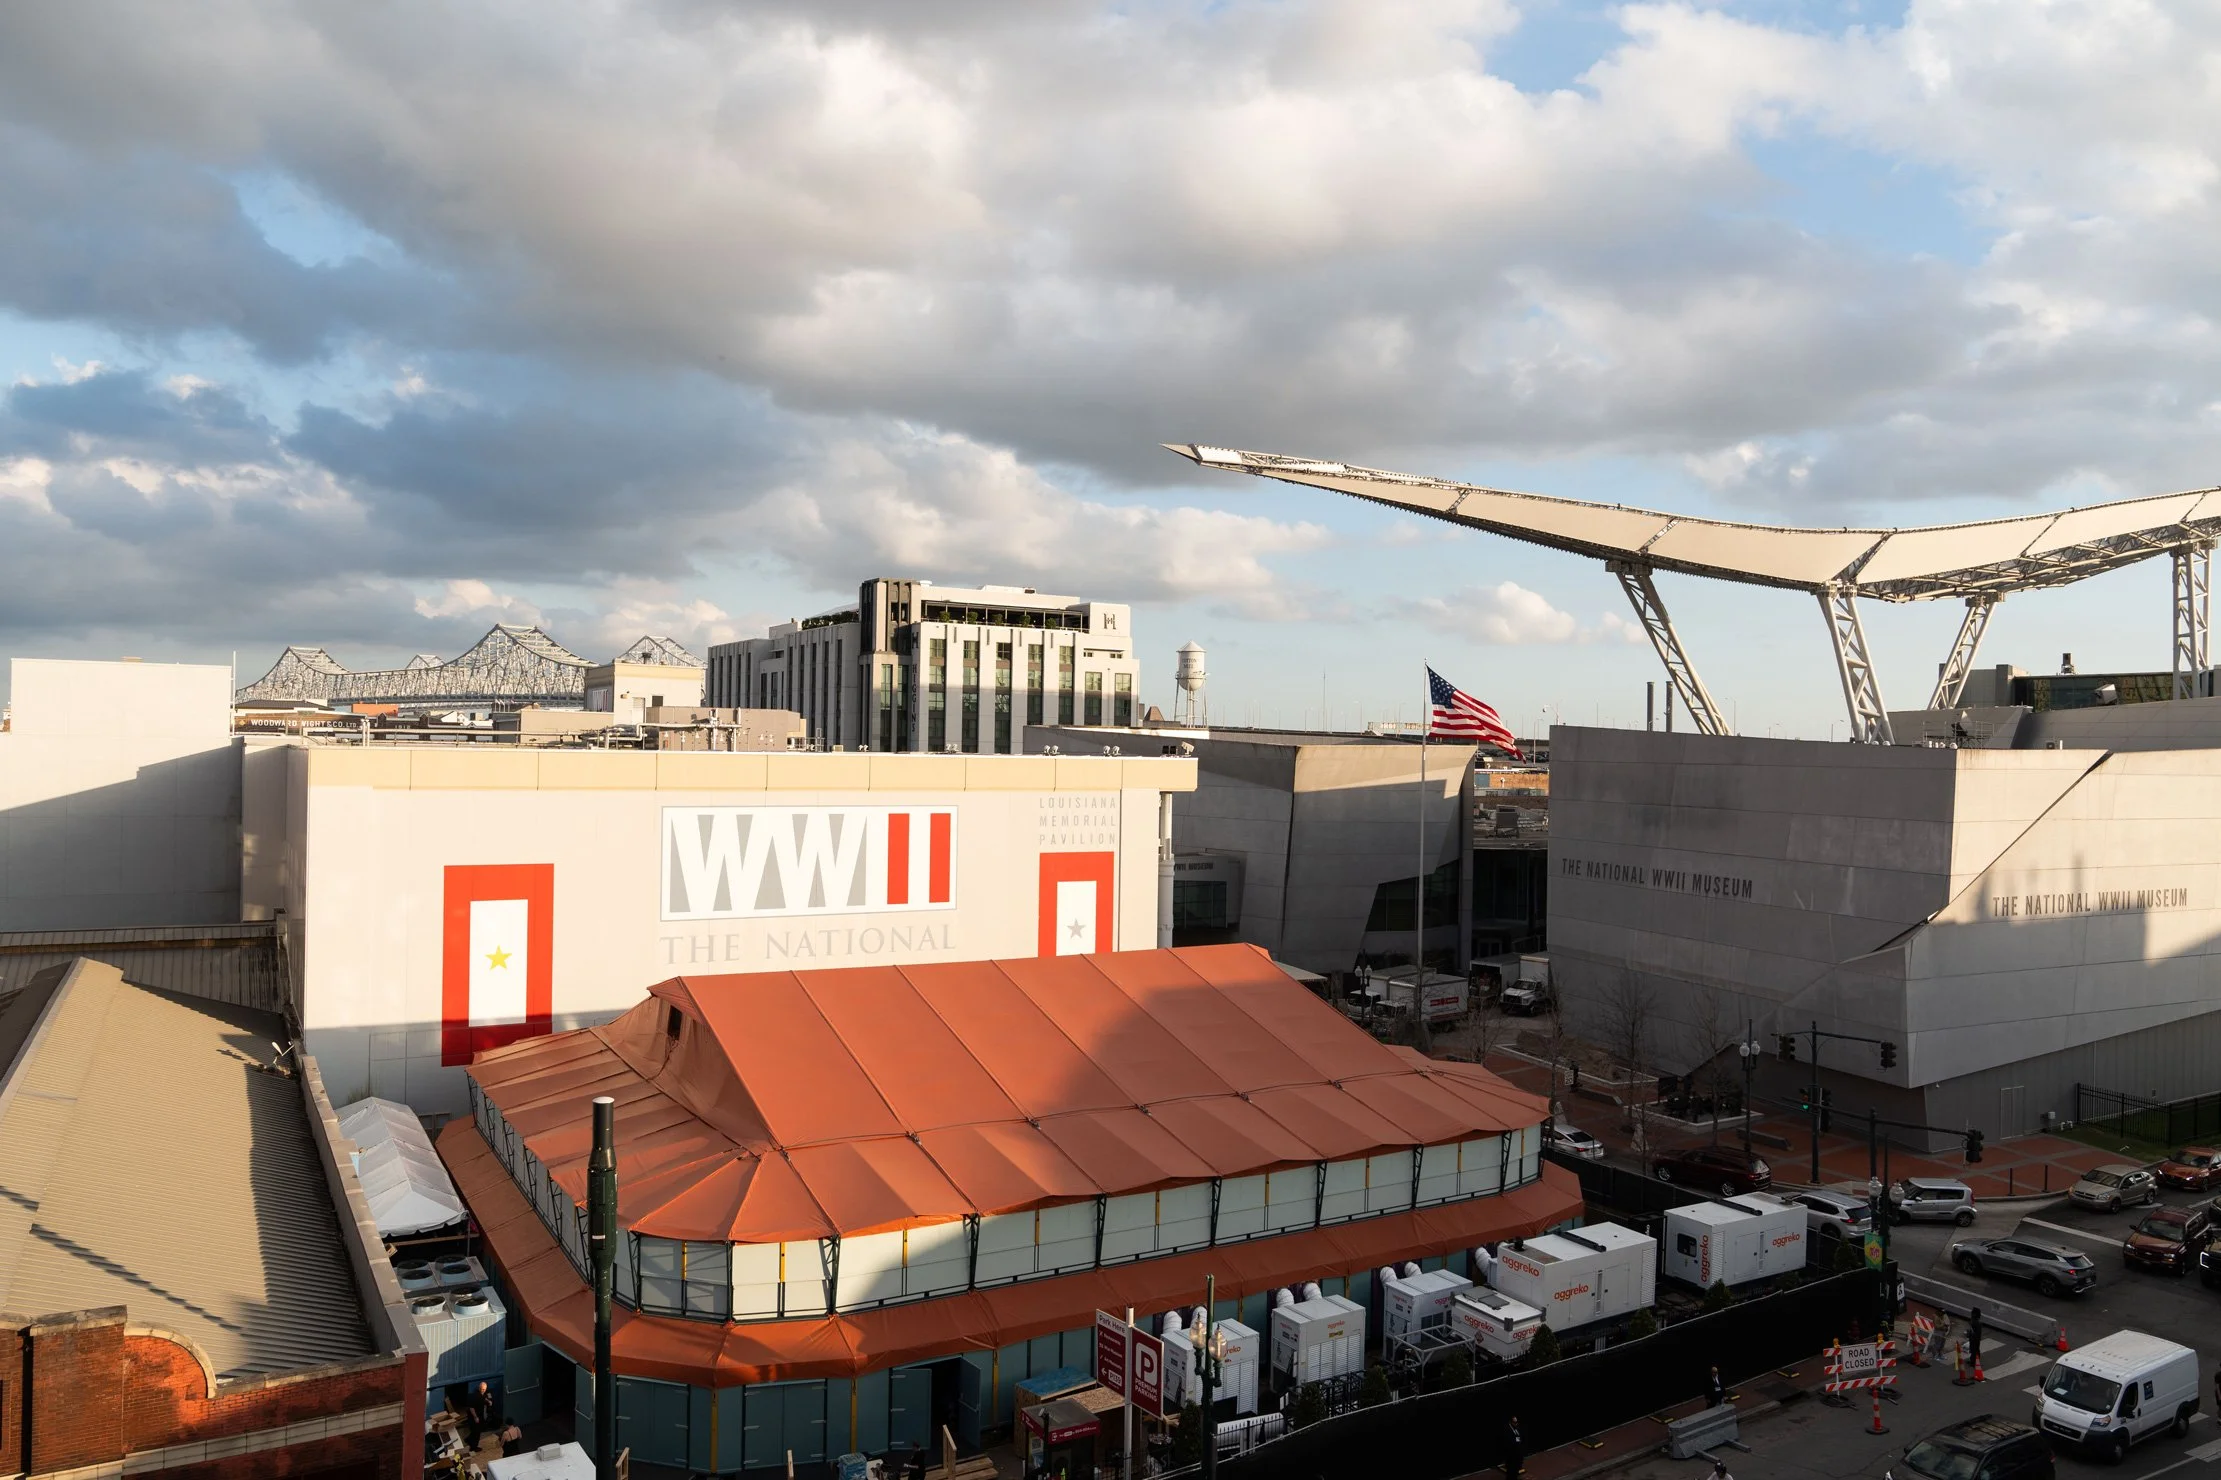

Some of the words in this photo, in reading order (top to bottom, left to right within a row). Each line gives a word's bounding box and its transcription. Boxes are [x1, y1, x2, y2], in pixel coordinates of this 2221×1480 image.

[250, 719, 298, 727] WOODWARD
[1039, 797, 1116, 809] LOUISIANA
[1039, 815, 1117, 827] MEMORIAL
[1039, 832, 1115, 845] PAVILION
[670, 813, 951, 912] WWII
[1562, 858, 1582, 876] THE
[1586, 861, 1645, 884] NATIONAL
[1652, 868, 1686, 890] WWII
[1692, 873, 1753, 898] MUSEUM
[1993, 896, 2018, 917] THE
[2025, 892, 2091, 916] NATIONAL
[2098, 890, 2130, 911] WWII
[2136, 888, 2188, 909] MUSEUM
[659, 933, 740, 965] THE
[765, 924, 957, 960] NATIONAL
[1772, 1232, 1801, 1248] aggreko
[1502, 1254, 1540, 1277] aggreko
[1699, 1235, 1711, 1283] aggreko
[1554, 1283, 1589, 1301] aggreko
[1434, 1297, 1449, 1305] aggr
[1099, 1314, 1111, 1327] Park
[1464, 1314, 1495, 1334] aggreko
[1512, 1324, 1538, 1340] aggrek
[1848, 1347, 1870, 1358] ROAD
[1844, 1358, 1875, 1369] CLOSED
[1135, 1377, 1158, 1396] PREMIUM
[1135, 1384, 1158, 1402] PARKING
